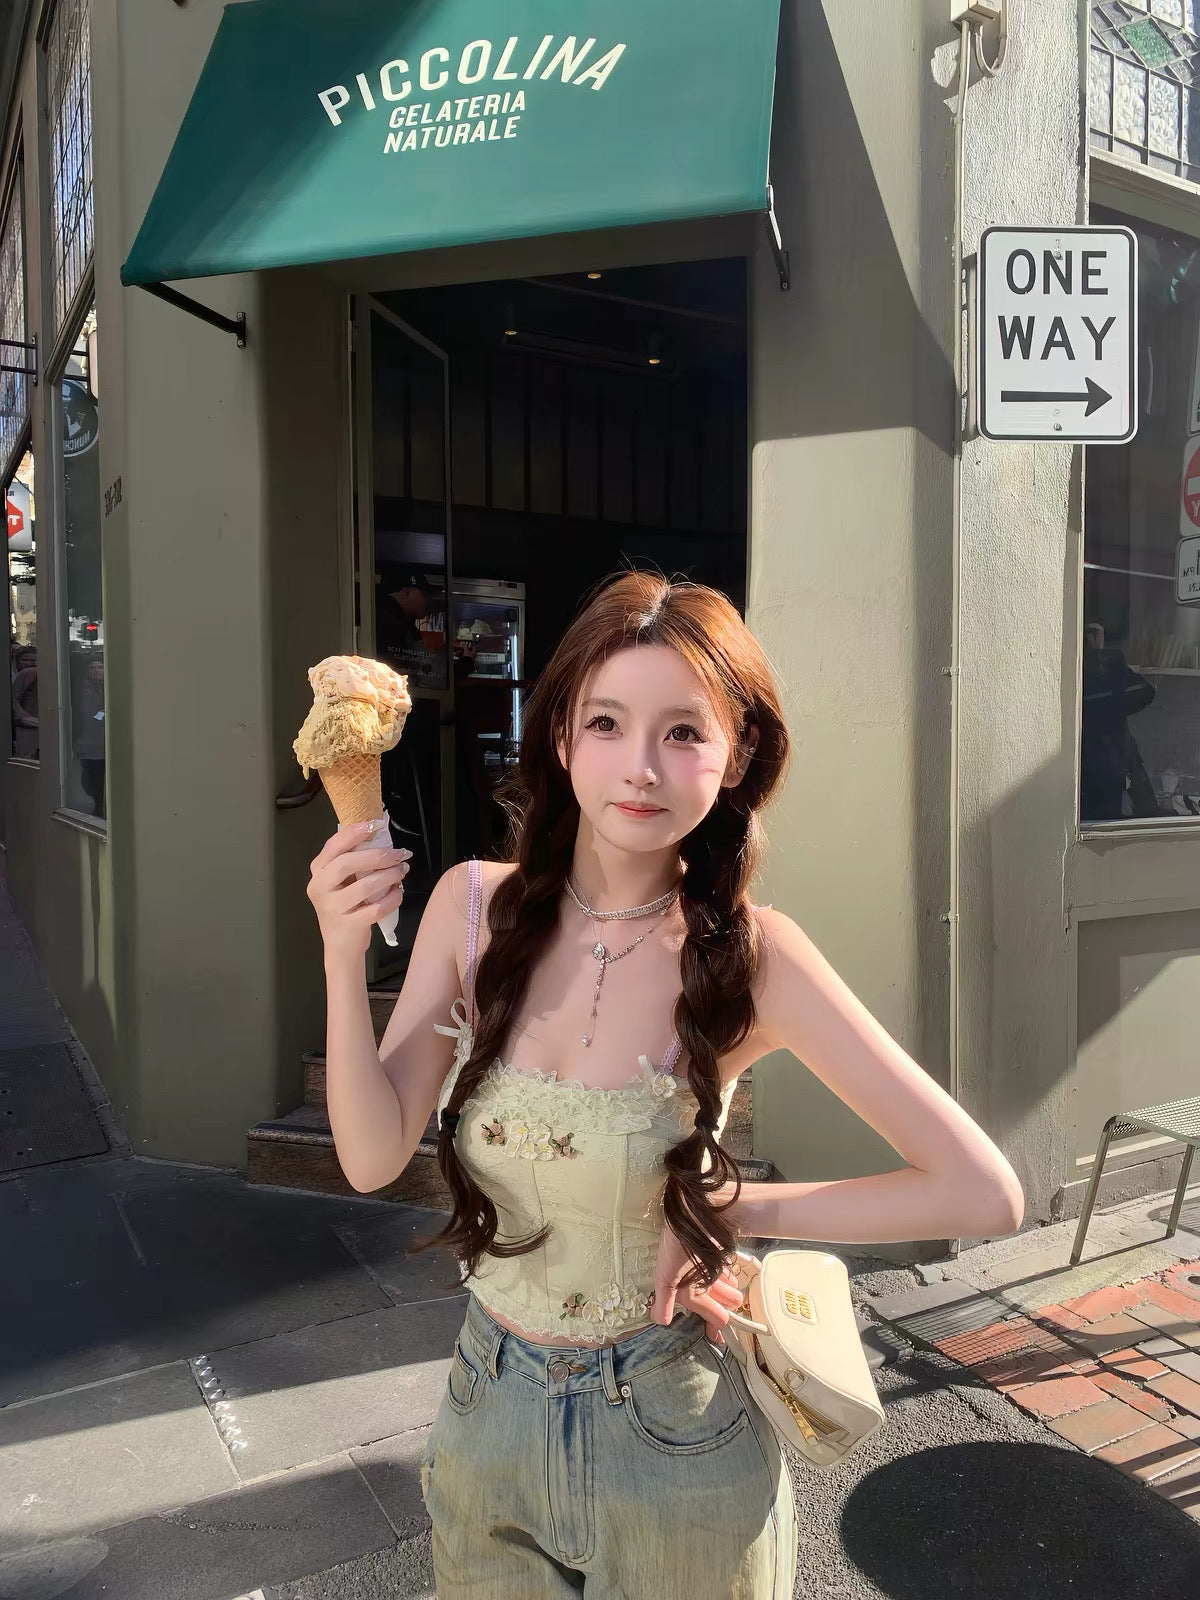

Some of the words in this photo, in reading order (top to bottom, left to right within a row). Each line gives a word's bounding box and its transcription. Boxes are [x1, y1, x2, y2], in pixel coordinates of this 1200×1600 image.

[317, 35, 627, 127] PICCOLINA
[388, 91, 527, 129] GELATERIA
[383, 115, 521, 154] NATURALE
[1006, 248, 1108, 295] ONE
[997, 315, 1117, 361] WAY
